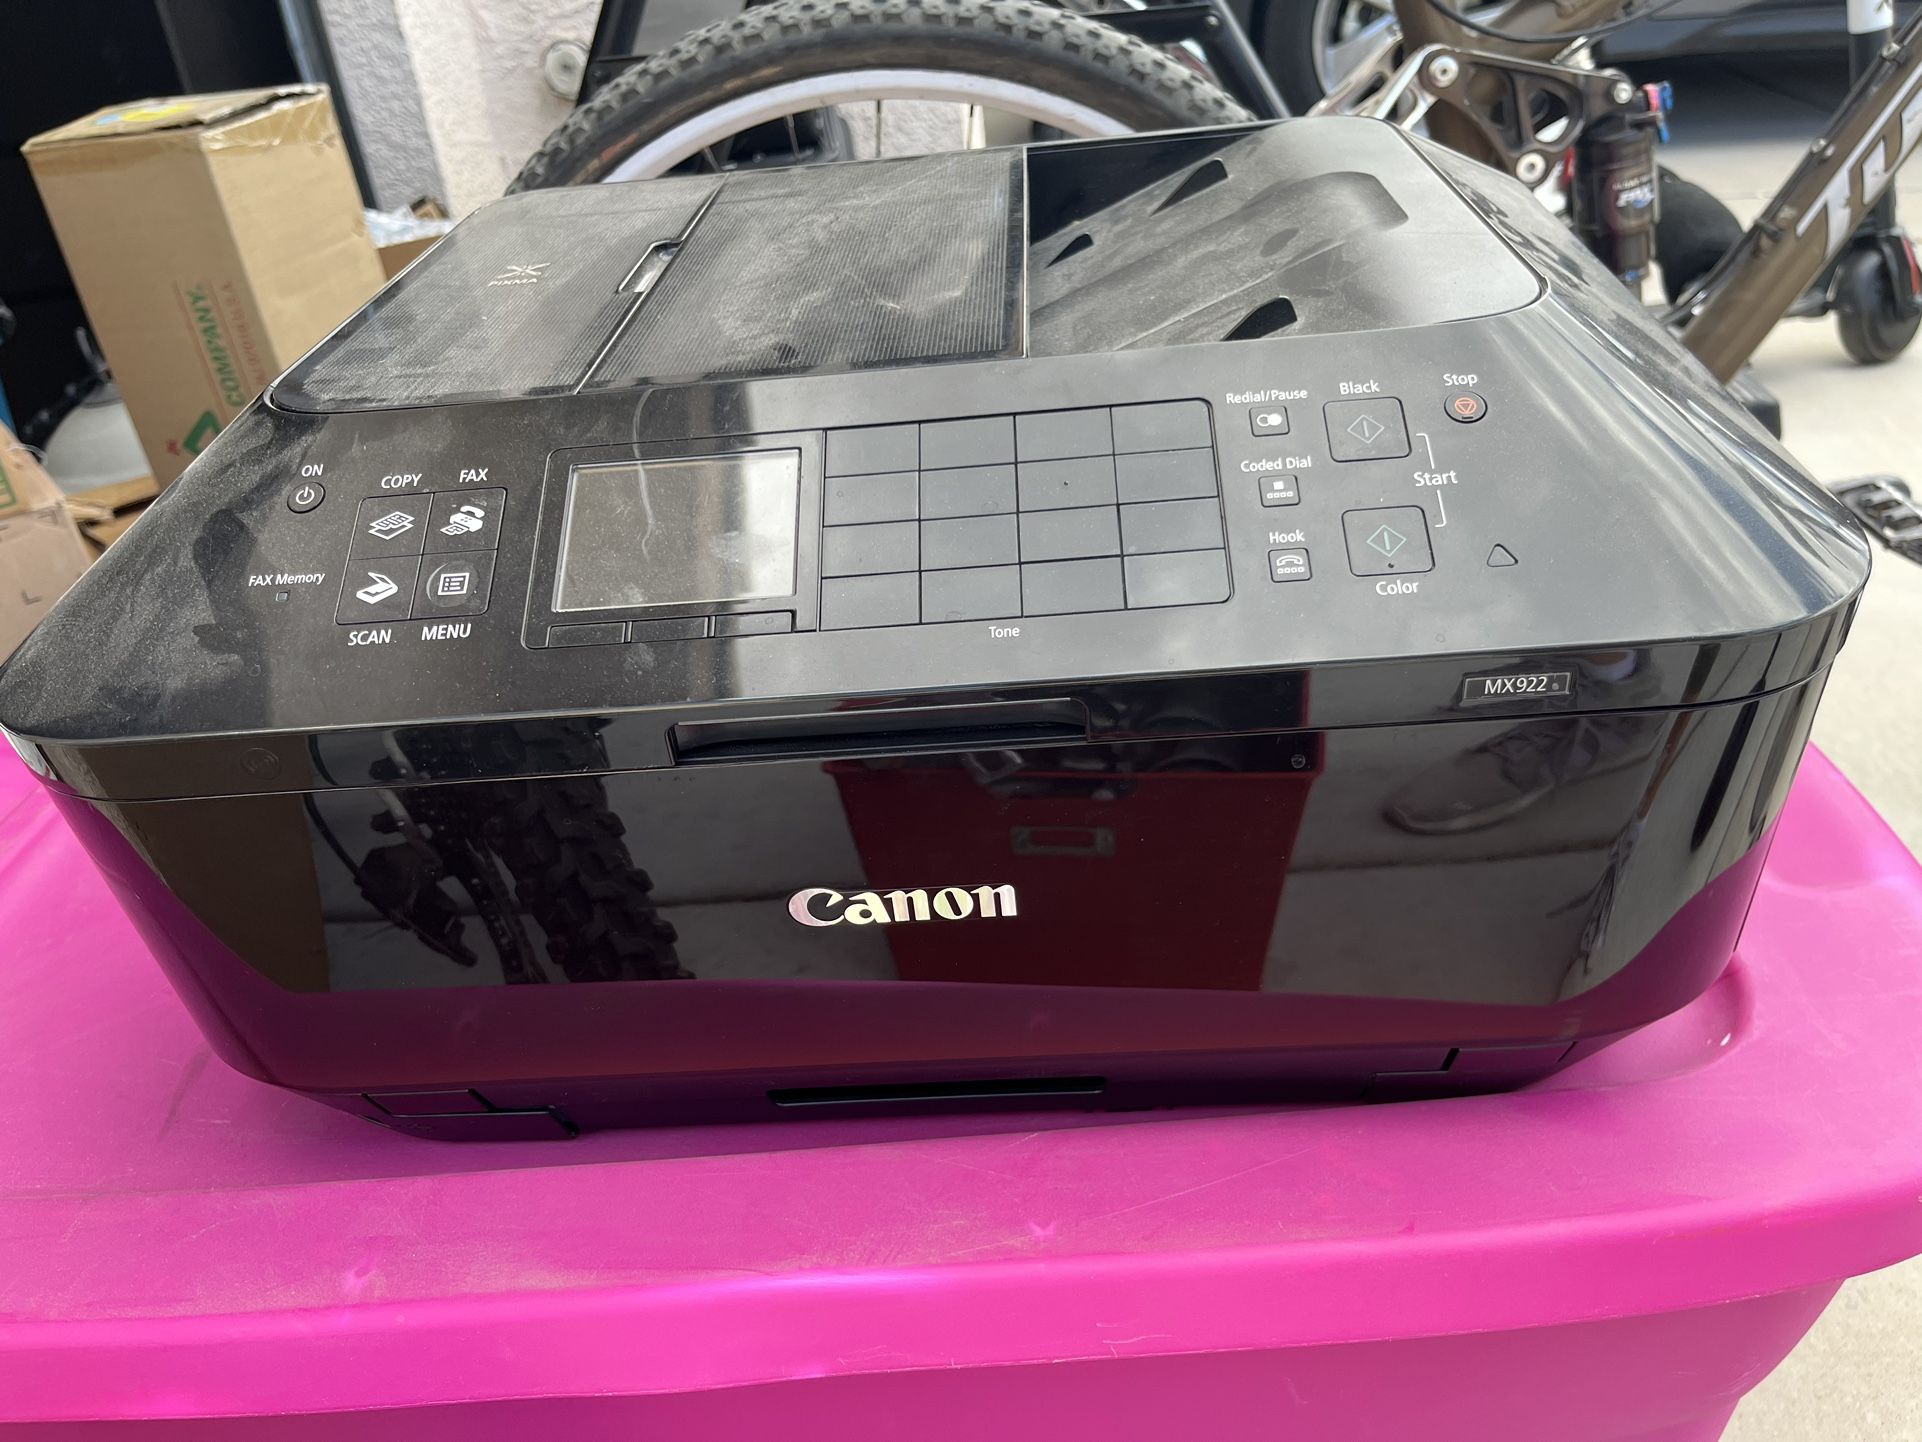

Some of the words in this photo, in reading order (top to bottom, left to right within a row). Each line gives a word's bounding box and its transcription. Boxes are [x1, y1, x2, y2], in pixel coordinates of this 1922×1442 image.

[487, 278, 538, 287] PIXMA
[1338, 379, 1380, 395] Black
[1442, 373, 1478, 387] Stop
[1225, 388, 1308, 404] Redial/Pause
[301, 463, 324, 478] ON
[1240, 457, 1282, 472] Coded
[1285, 455, 1312, 470] Dial
[380, 473, 423, 489] COPY
[459, 468, 489, 483] FAX
[1413, 469, 1458, 487] Start
[1268, 529, 1305, 544] Hook
[248, 573, 273, 587] FAX
[275, 572, 326, 587] Memory
[1375, 578, 1420, 596] Color
[347, 629, 392, 646] SCAN
[421, 623, 472, 641] MENU
[988, 625, 1021, 639] Tone
[1484, 676, 1547, 695] MX922
[788, 884, 1018, 927] Canon
